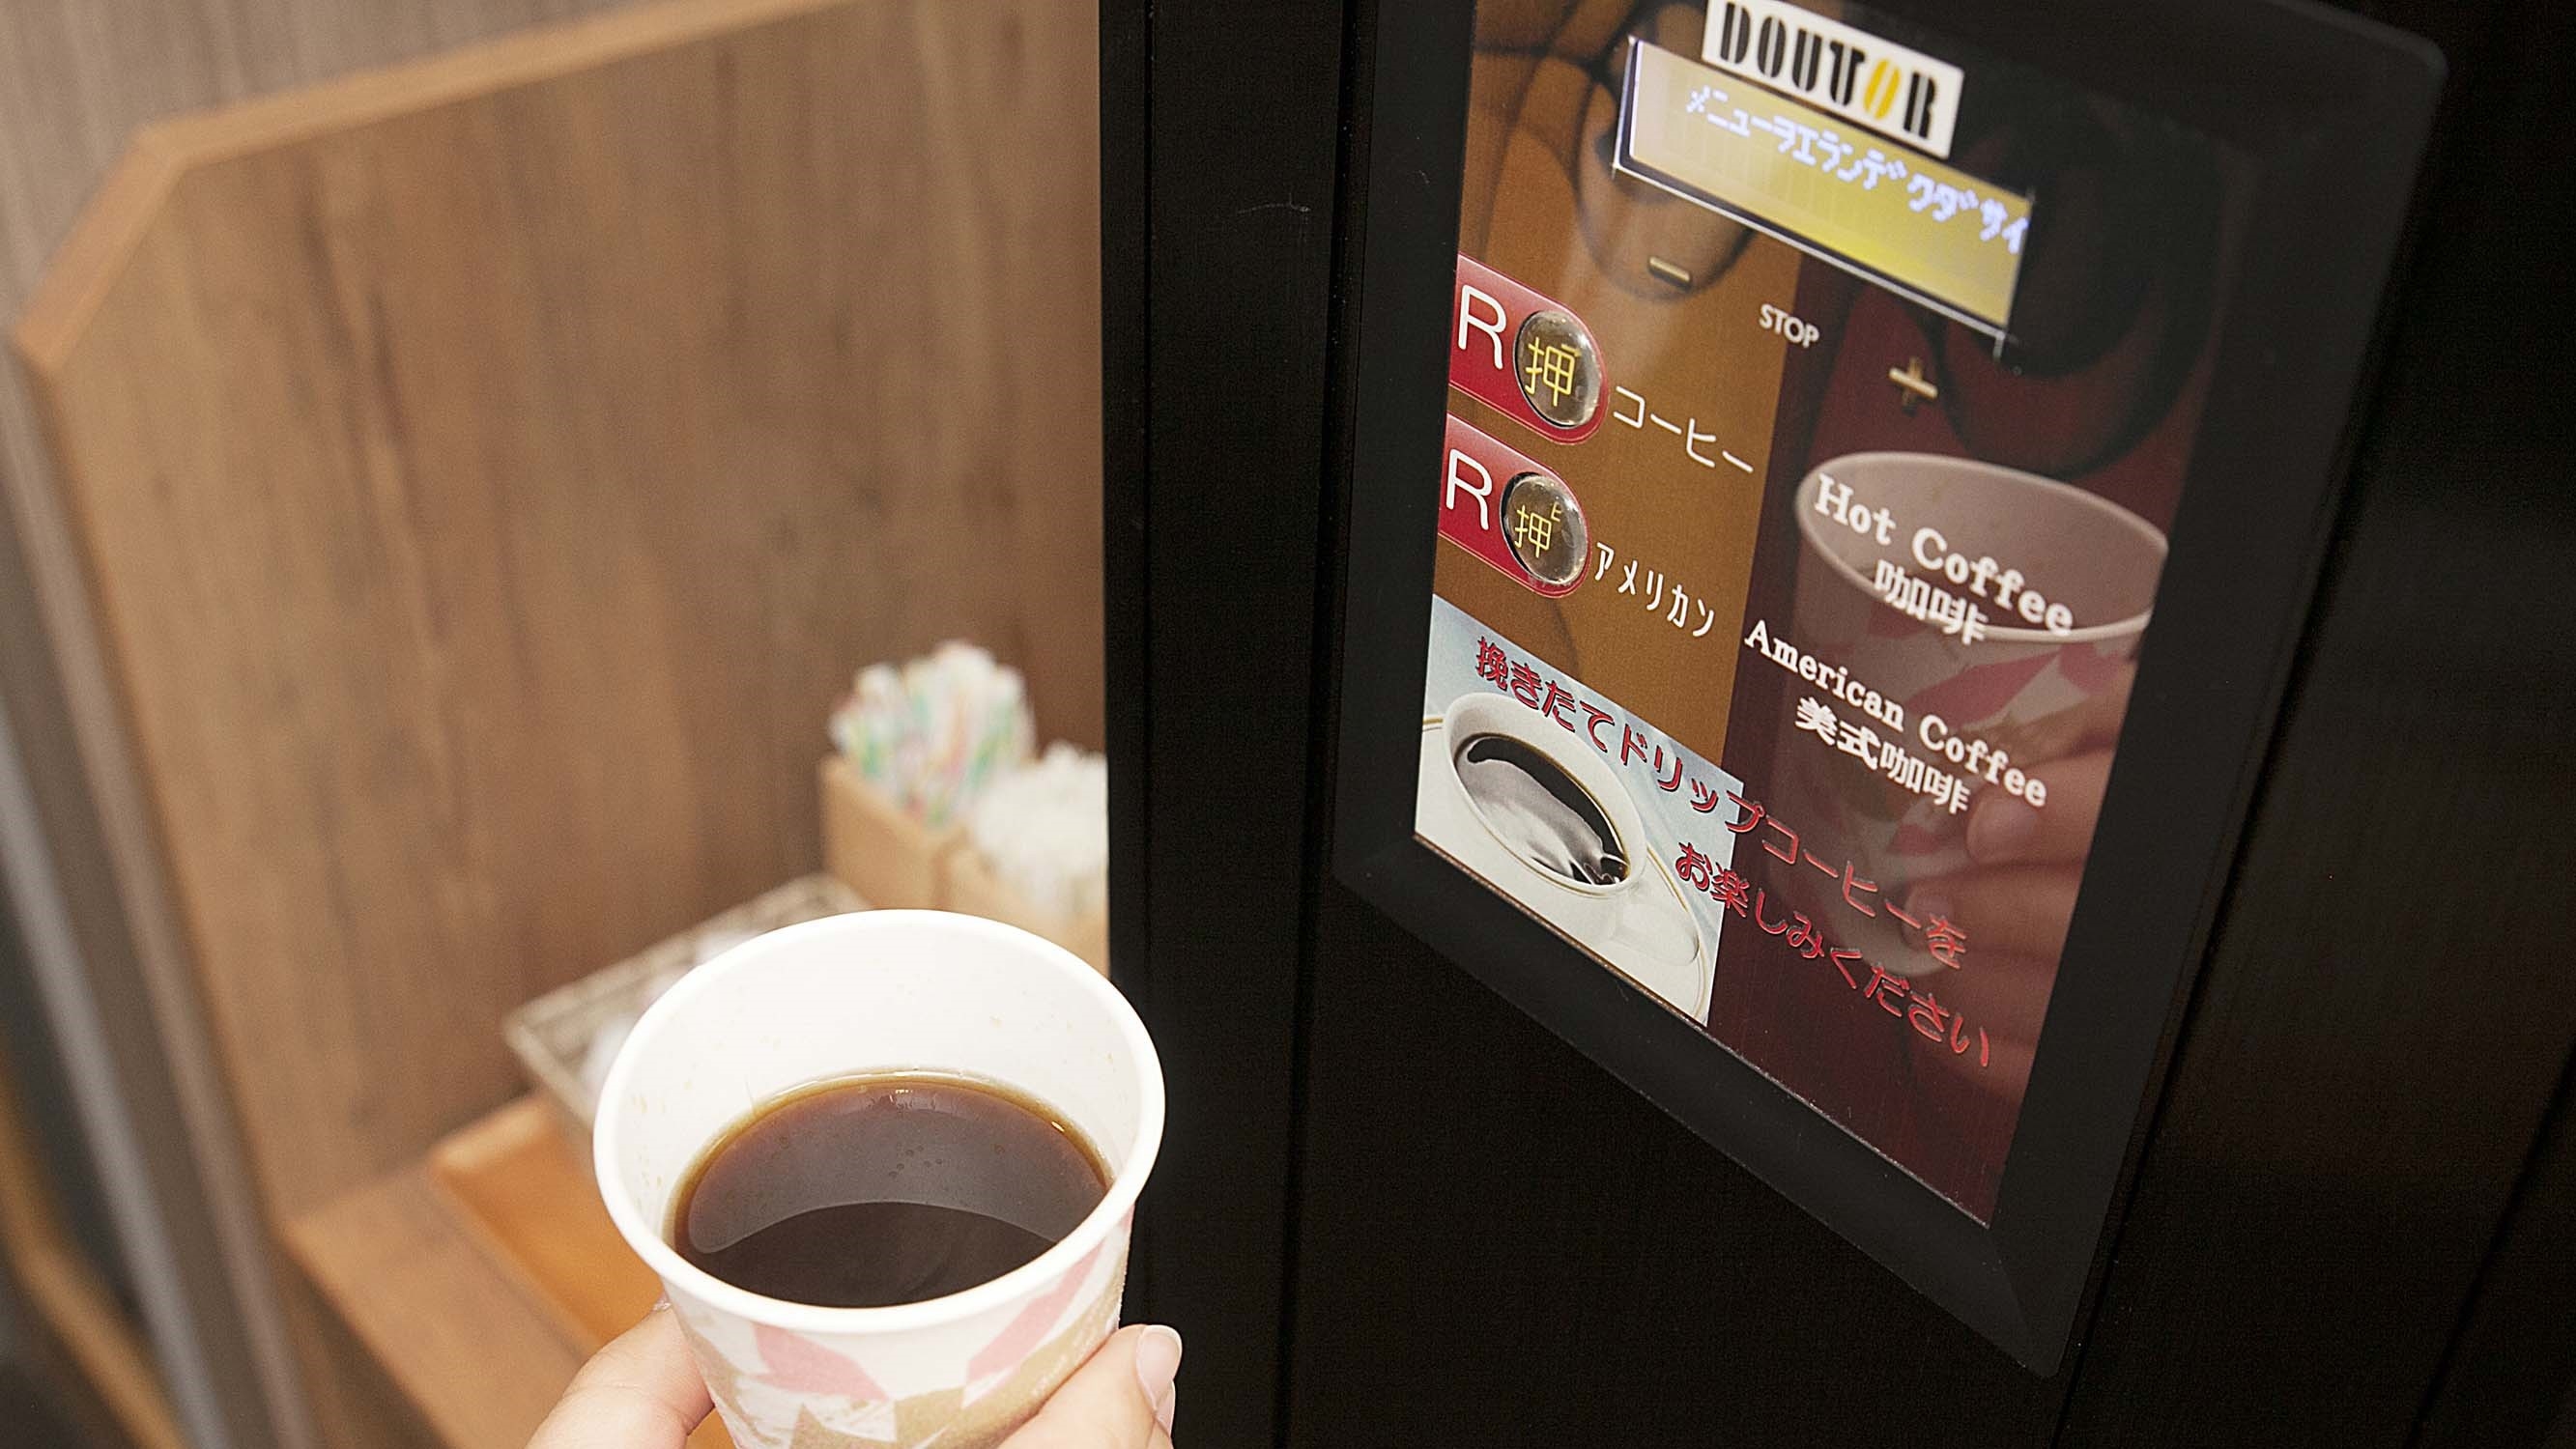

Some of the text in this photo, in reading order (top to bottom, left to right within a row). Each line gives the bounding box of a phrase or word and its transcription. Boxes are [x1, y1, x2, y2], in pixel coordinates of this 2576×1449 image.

[1720, 2, 1936, 138] DOUTOR
[1458, 284, 1507, 370] R
[1525, 336, 1576, 407] 押
[1759, 302, 1820, 349] STOP
[1614, 385, 1754, 473] コーヒー
[1445, 448, 1493, 531] R
[1594, 542, 1715, 638] アメリカン
[1815, 472, 2074, 637] Hot Coffee
[1875, 559, 1989, 646] 咖啡
[1744, 620, 2048, 809] American Coffee
[1794, 696, 1973, 815] 美式咖啡
[1475, 637, 1966, 969] 挽きたてドリップコーヒーを
[1675, 841, 1989, 1067] お楽しみください
